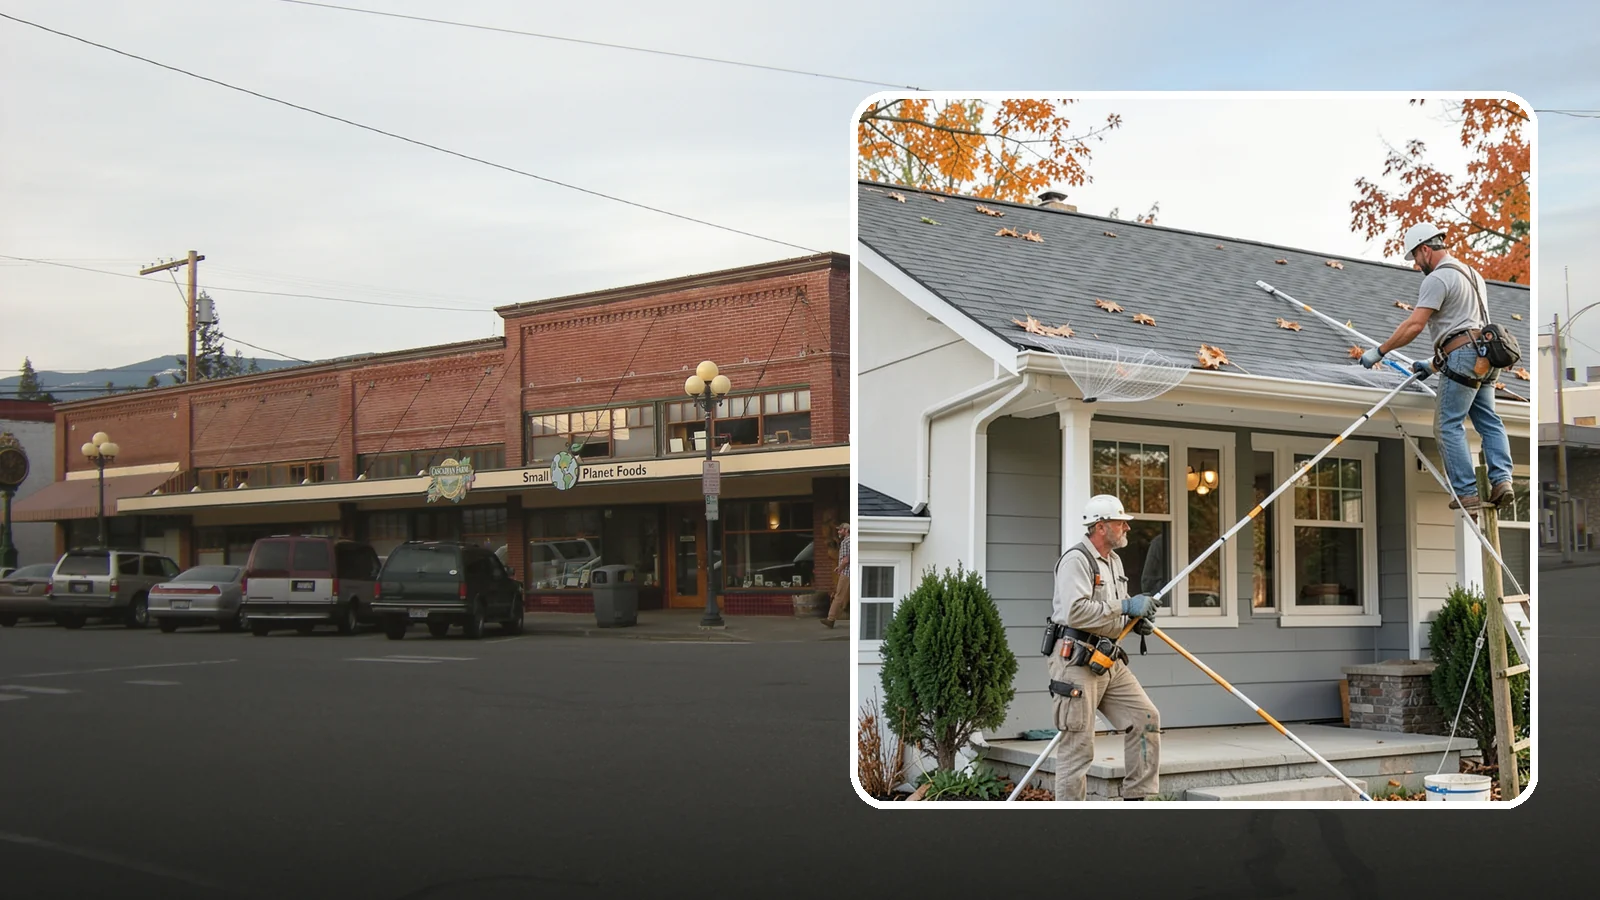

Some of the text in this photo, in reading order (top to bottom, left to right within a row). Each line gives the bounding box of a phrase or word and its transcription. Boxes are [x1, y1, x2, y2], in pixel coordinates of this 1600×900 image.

[523, 464, 647, 483] Small Planet Foods
